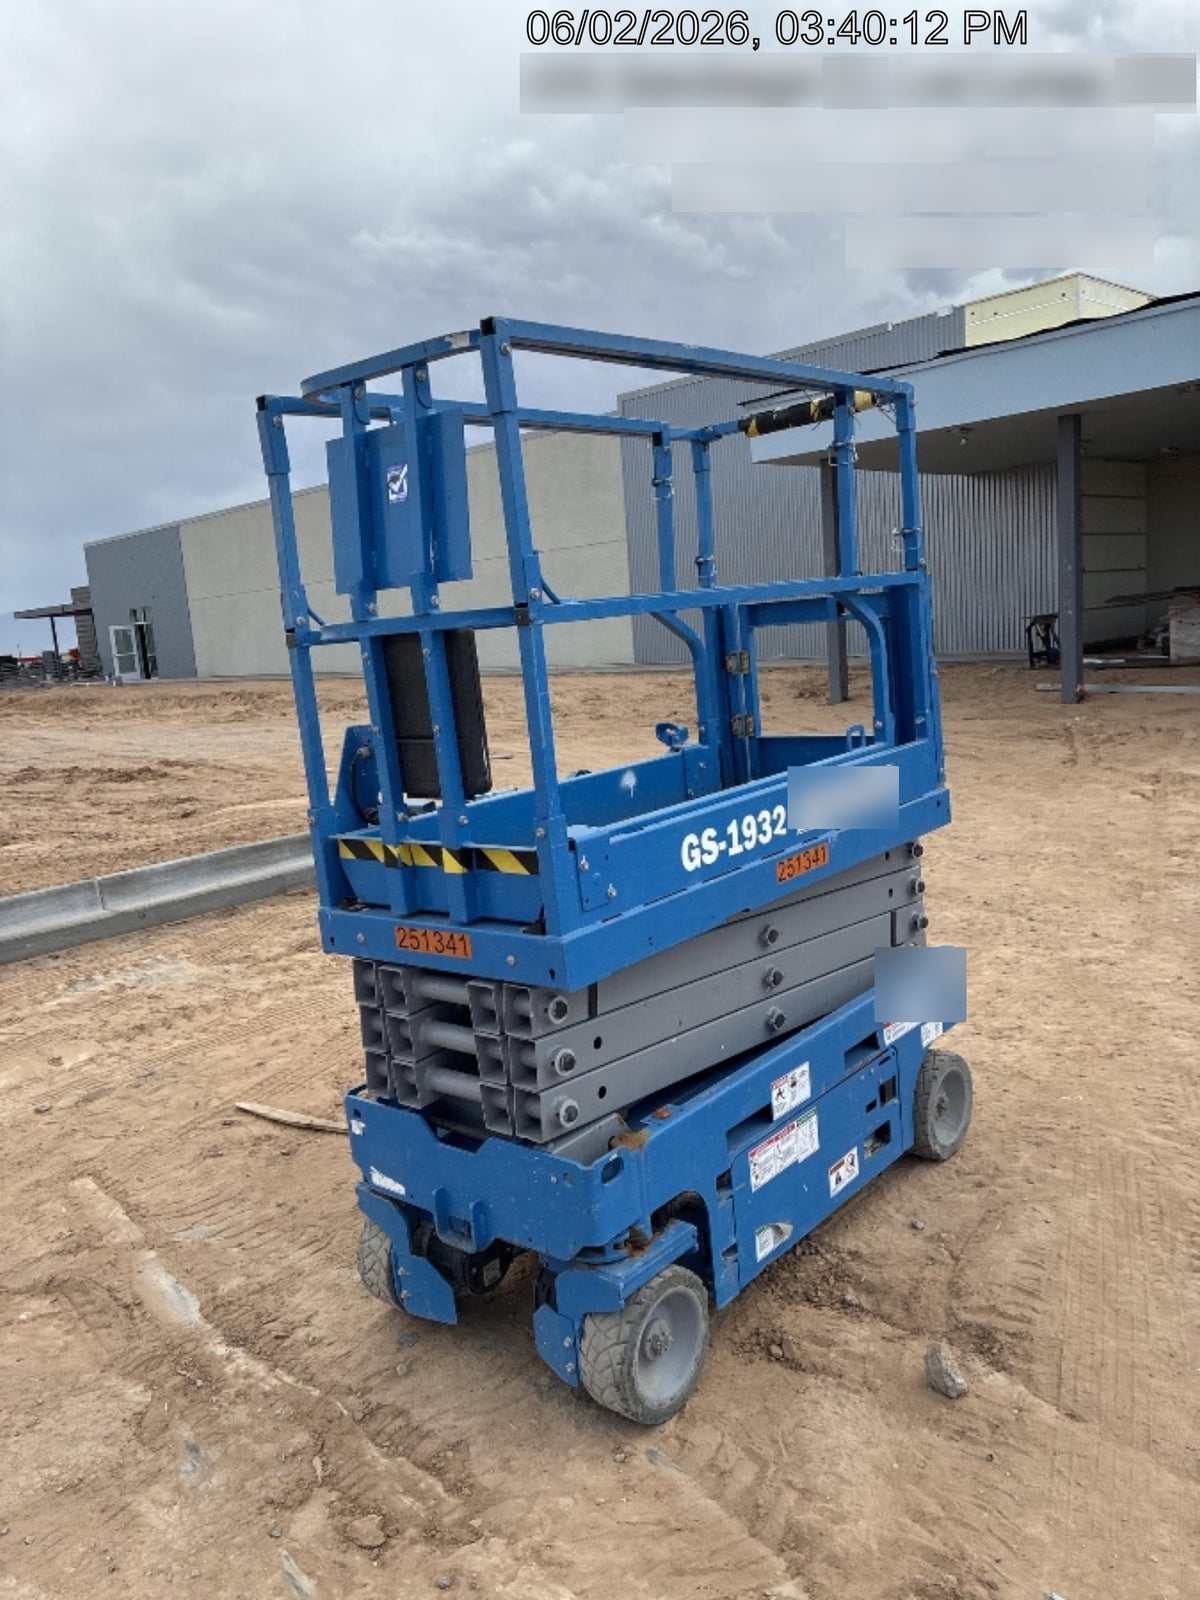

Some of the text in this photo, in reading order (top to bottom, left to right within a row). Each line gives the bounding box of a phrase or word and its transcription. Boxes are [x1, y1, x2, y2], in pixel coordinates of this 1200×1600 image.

[681, 804, 787, 872] GS-1932
[777, 844, 828, 883] 251341
[396, 926, 469, 957] 251341
